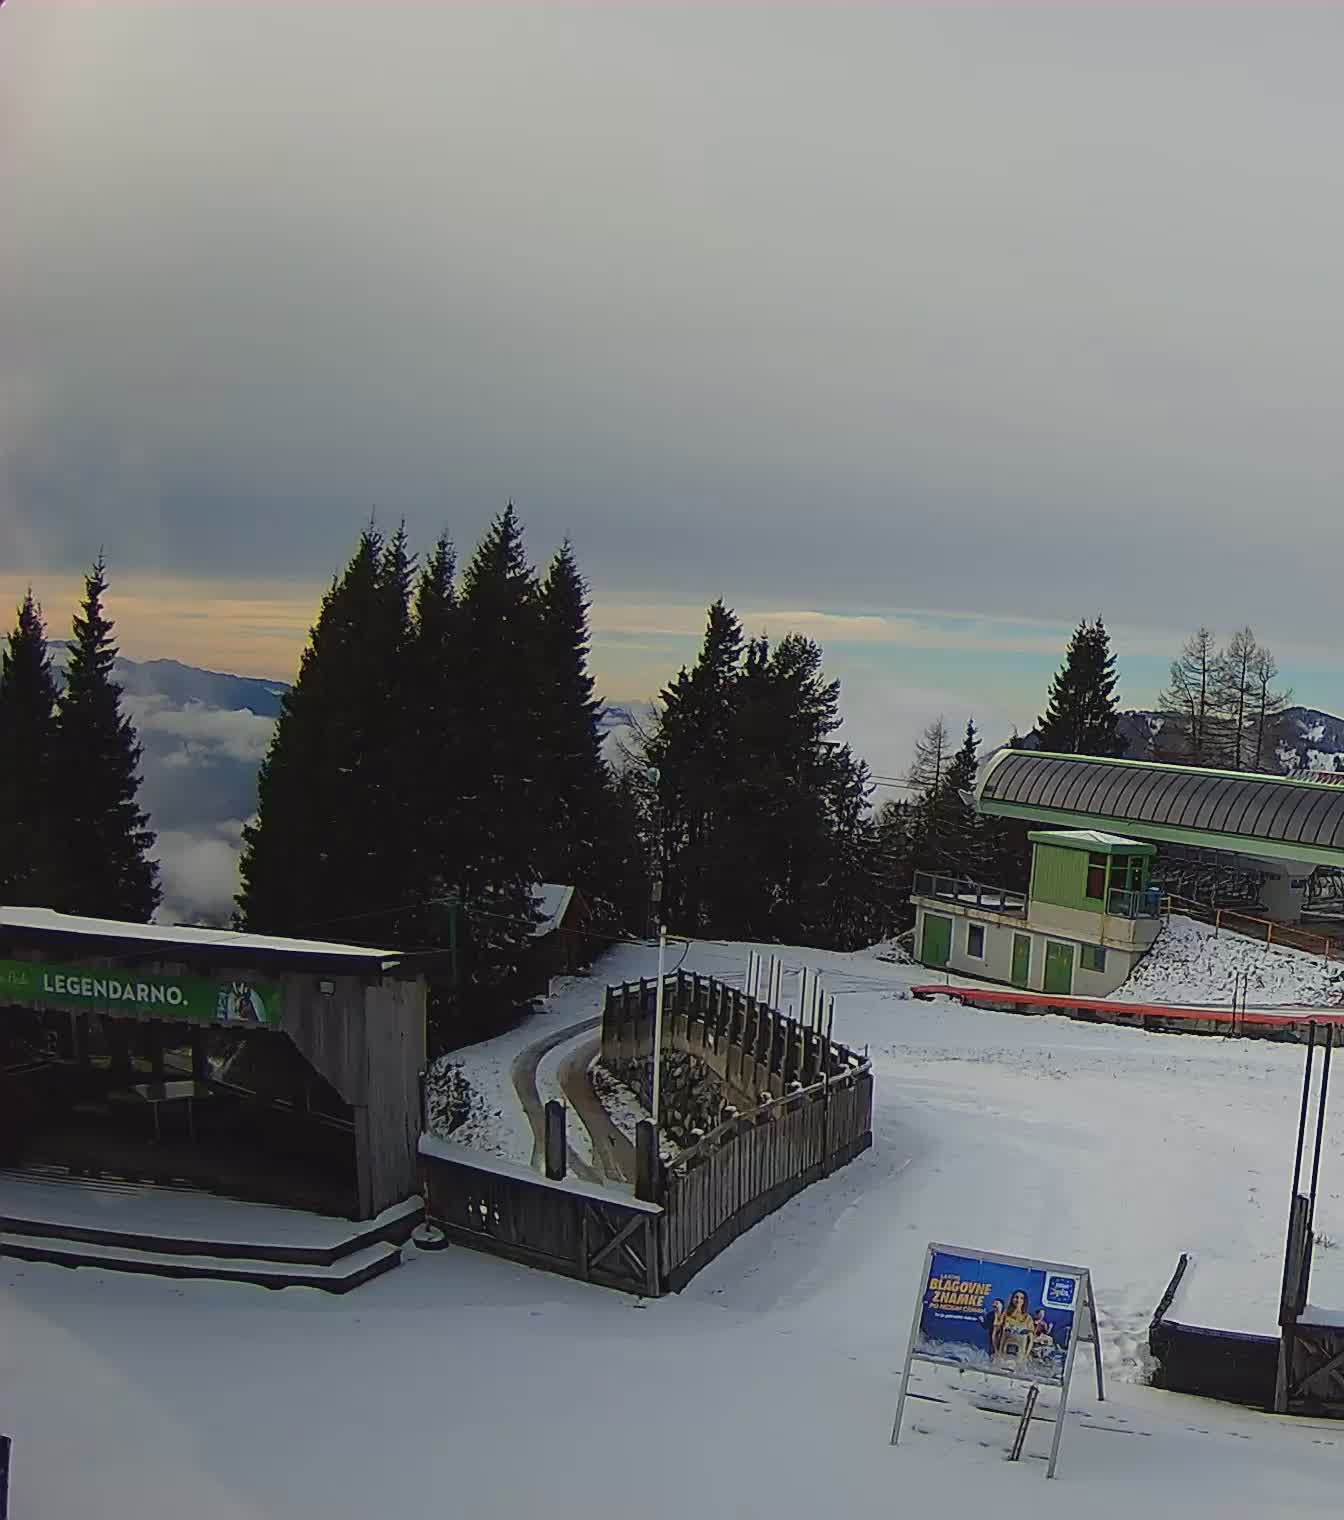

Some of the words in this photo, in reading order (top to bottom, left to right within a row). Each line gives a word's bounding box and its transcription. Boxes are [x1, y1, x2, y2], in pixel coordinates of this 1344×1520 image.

[44, 973, 189, 1006] LEGENDARNO.
[930, 1278, 992, 1295] BLAGOVNE
[933, 1291, 985, 1307] ZNAMKE
